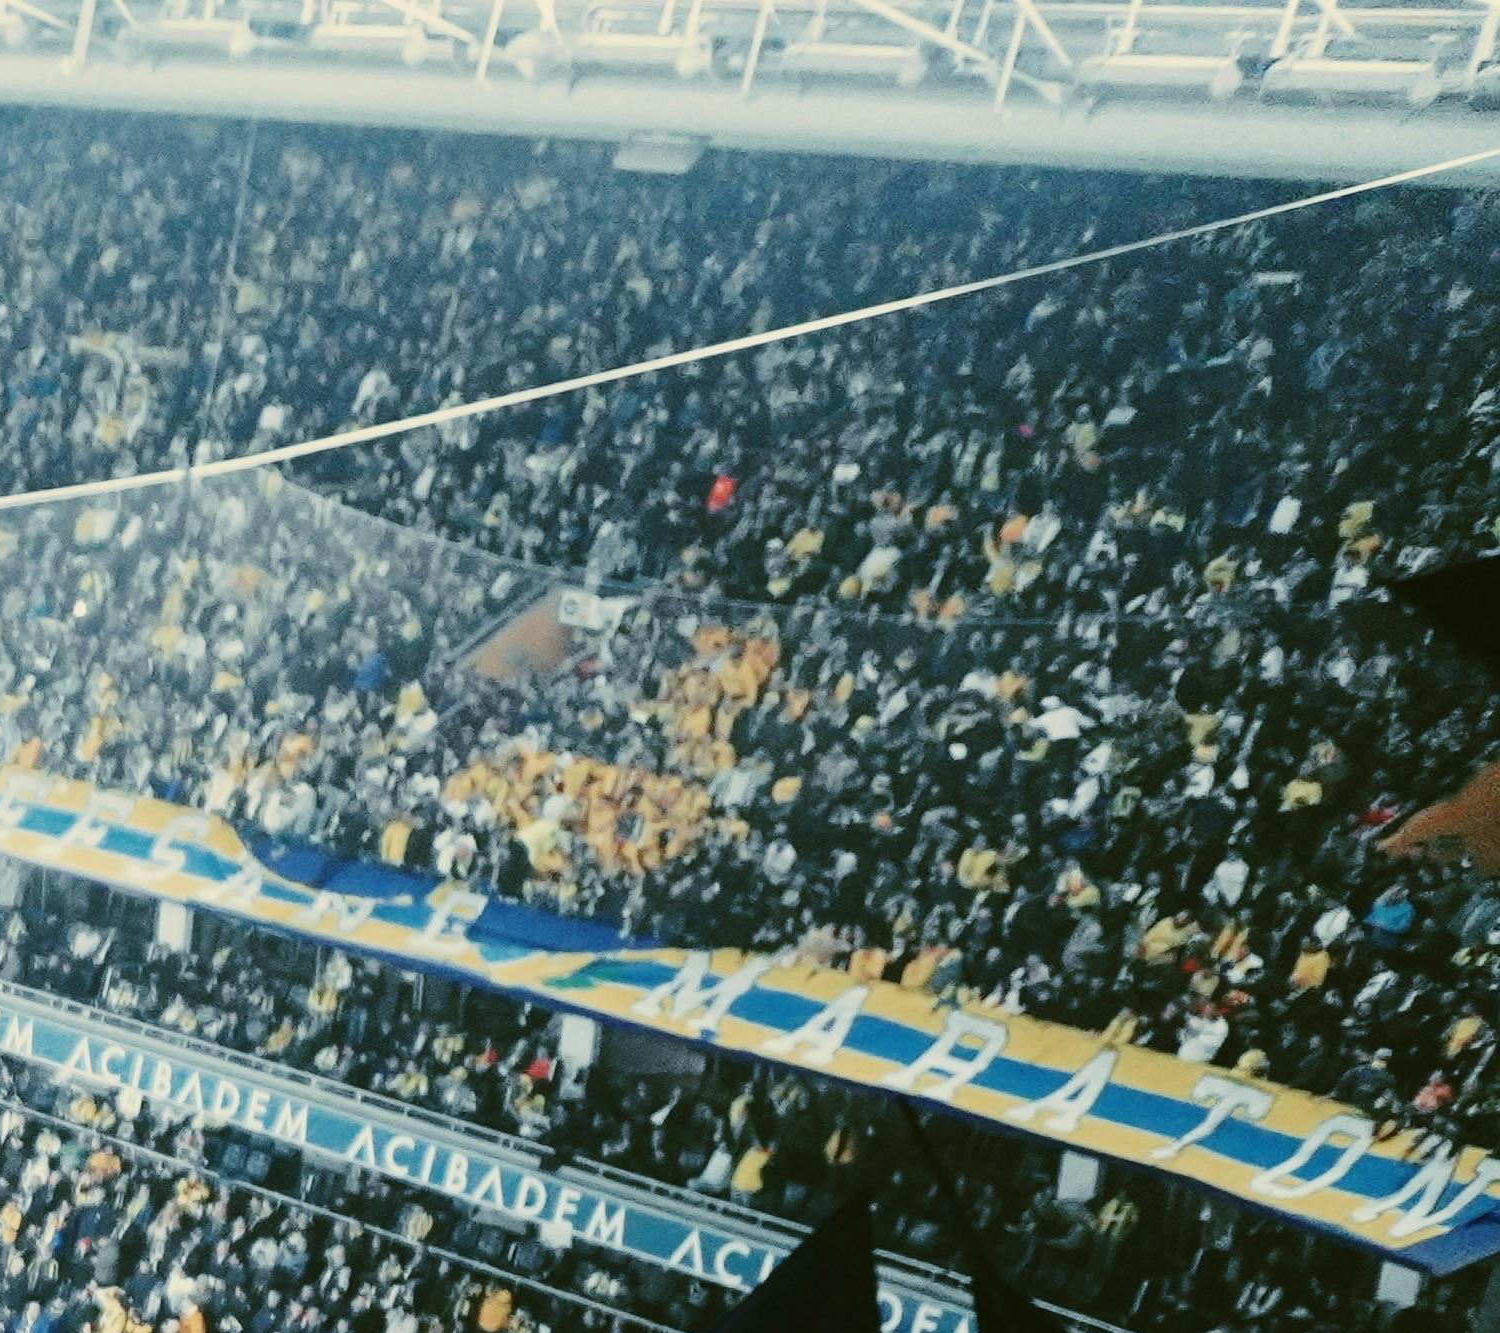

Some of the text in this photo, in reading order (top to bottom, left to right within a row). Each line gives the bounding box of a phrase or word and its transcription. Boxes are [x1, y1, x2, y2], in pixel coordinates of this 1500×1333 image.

[61, 1035, 309, 1144] ACIBADEM
[630, 951, 1500, 1240] MARATON
[344, 1124, 627, 1248] ACIBADEM
